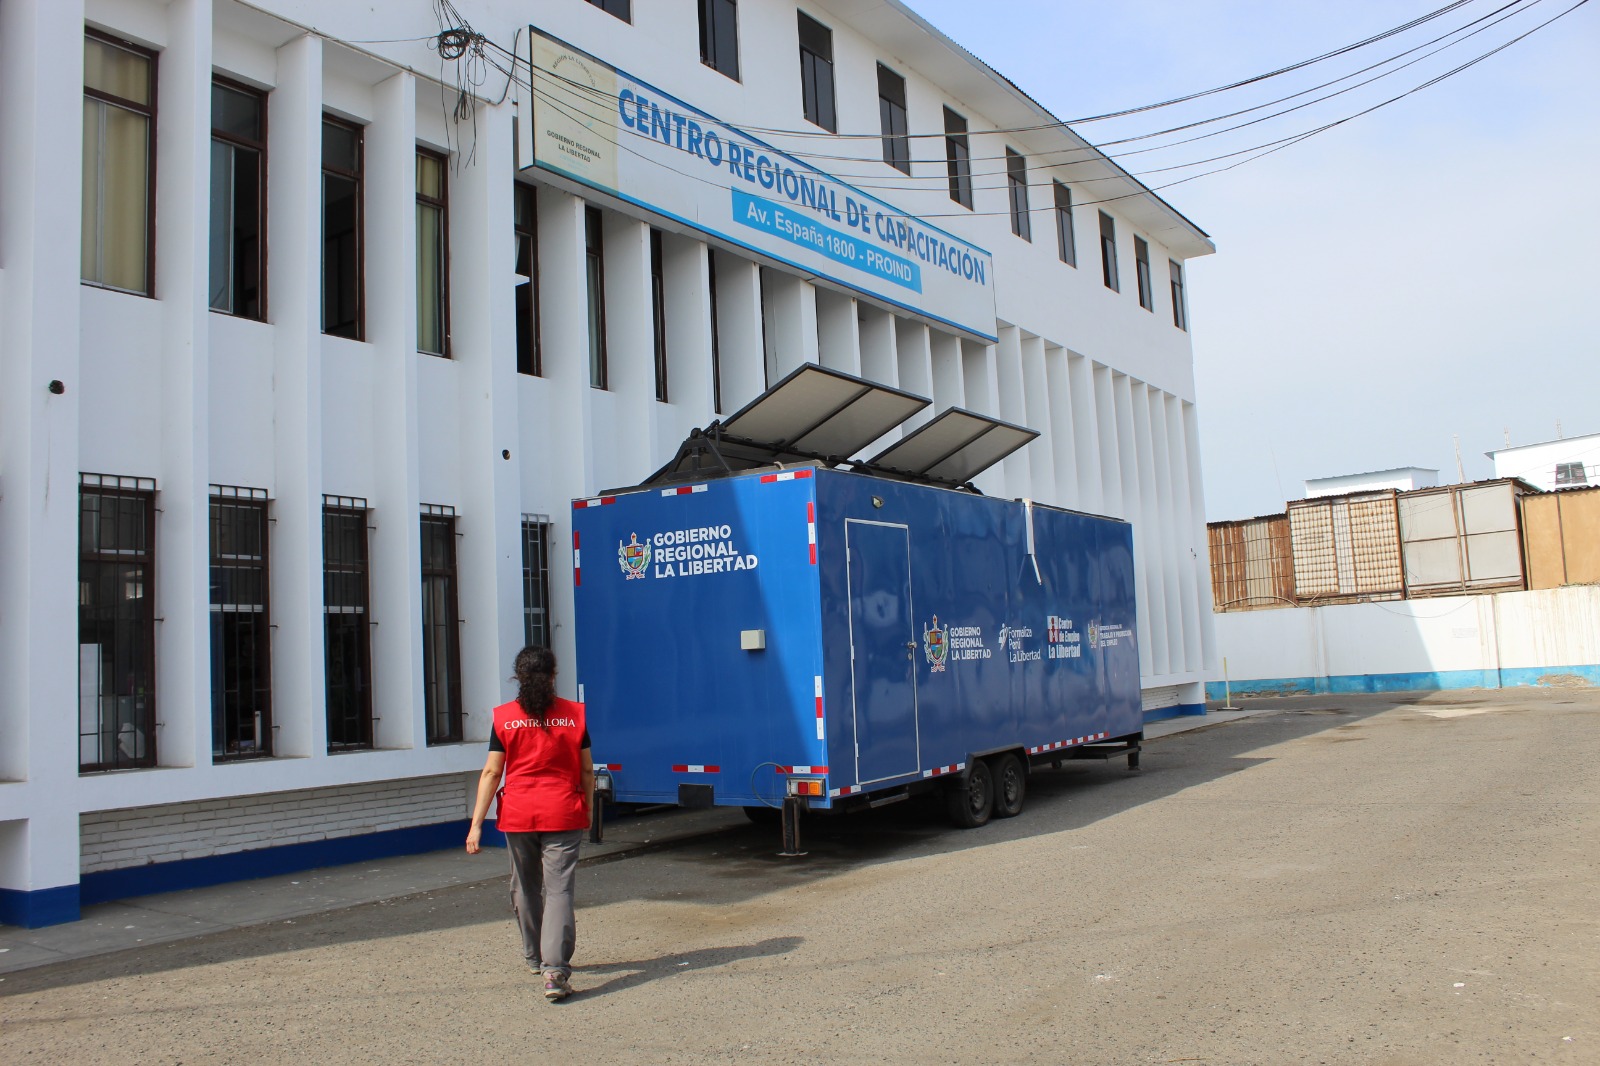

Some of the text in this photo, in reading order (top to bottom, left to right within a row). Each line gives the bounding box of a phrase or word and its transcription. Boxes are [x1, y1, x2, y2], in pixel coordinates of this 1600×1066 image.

[546, 130, 601, 159] GOBIERNO REGIONAL
[558, 144, 566, 152] LA
[566, 148, 591, 163] LIBERTAD
[618, 88, 986, 286] CENTRO REGIONAL DE CAPACITACIÓN
[747, 202, 770, 226] Av.
[774, 210, 824, 248] España
[826, 234, 856, 261] 1800
[867, 250, 912, 282] PROIND
[653, 524, 731, 546] GOBIERNO
[654, 541, 738, 563] REGIONAL
[655, 554, 758, 579] LA LIBERTAD
[950, 626, 981, 637] GOBIERNO
[1058, 617, 1073, 630] Centro
[1008, 625, 1033, 639] Formaliza
[1059, 631, 1080, 644] de Empleo
[951, 637, 984, 649] REGIONAL
[1048, 643, 1081, 659] La Libertad
[952, 648, 992, 661] LA LIBERTAD
[1009, 648, 1041, 663] La Libertad
